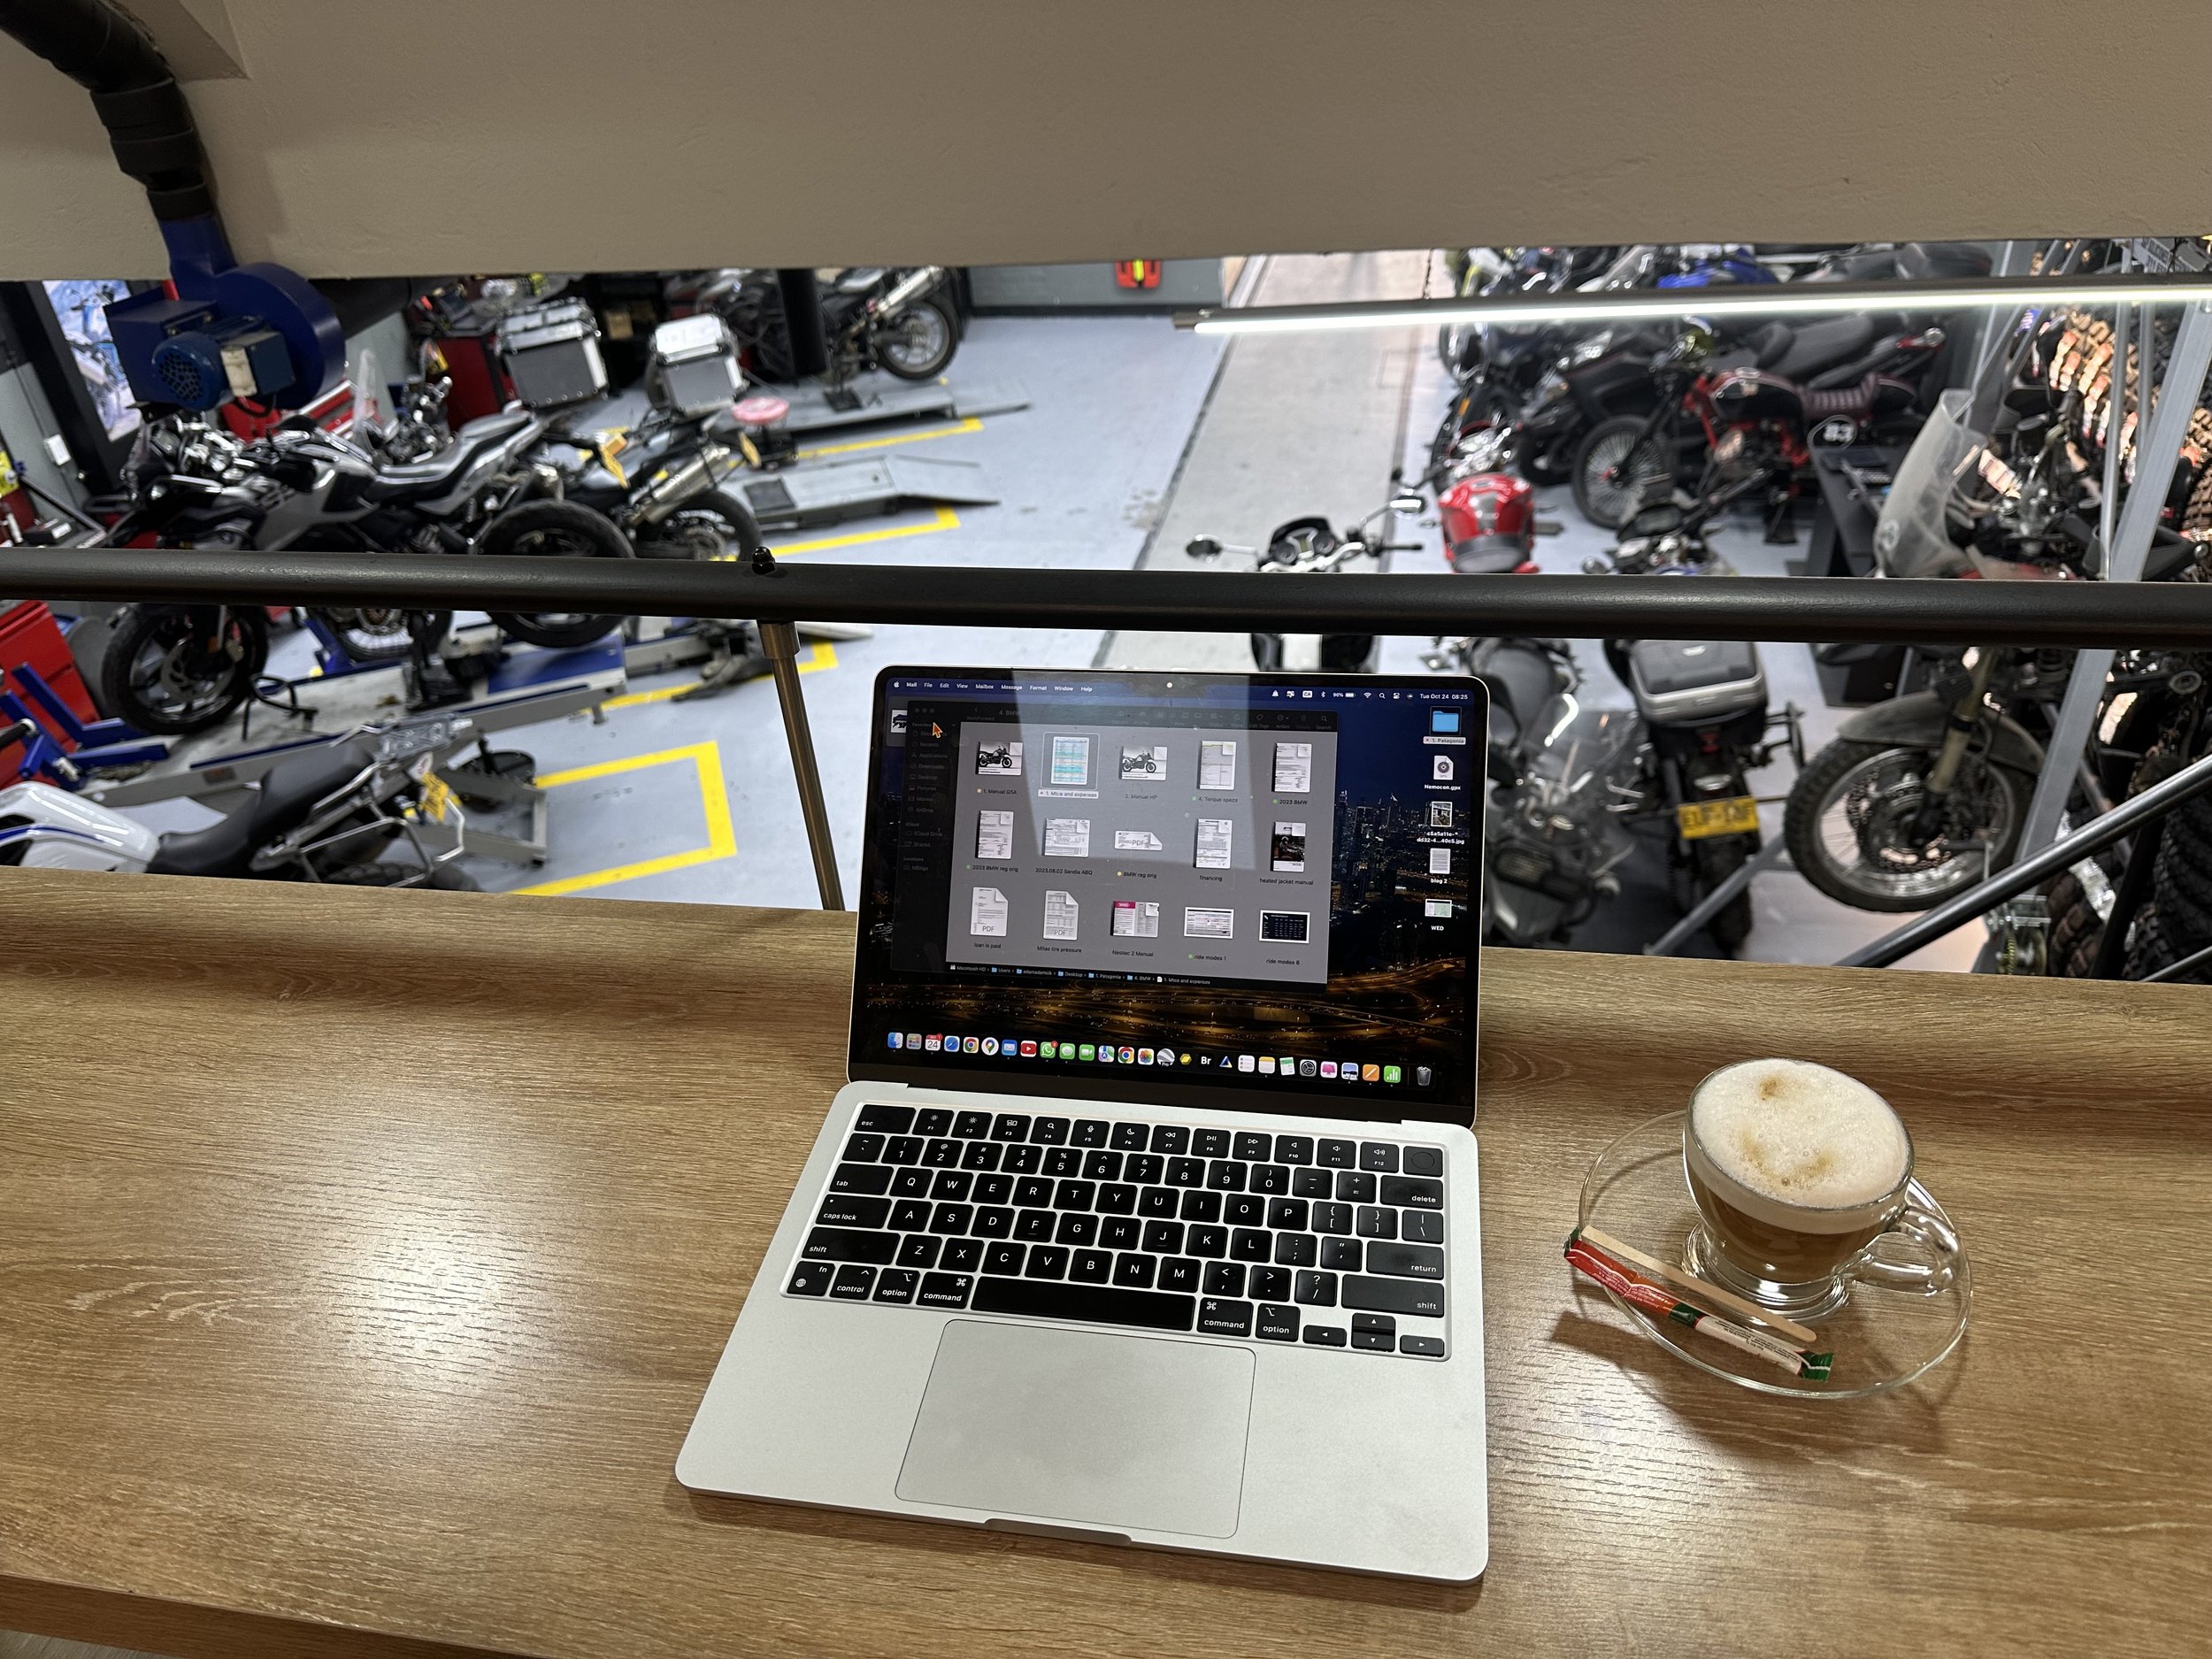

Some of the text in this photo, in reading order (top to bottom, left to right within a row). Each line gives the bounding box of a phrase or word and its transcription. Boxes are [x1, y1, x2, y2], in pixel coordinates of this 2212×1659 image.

[908, 1178, 915, 1187] Q
[1248, 1240, 1254, 1248] L
[915, 1246, 924, 1255] Z
[957, 1249, 966, 1258] X
[1001, 1253, 1009, 1262] C
[1044, 1256, 1052, 1265] V
[1174, 1269, 1185, 1278] M
